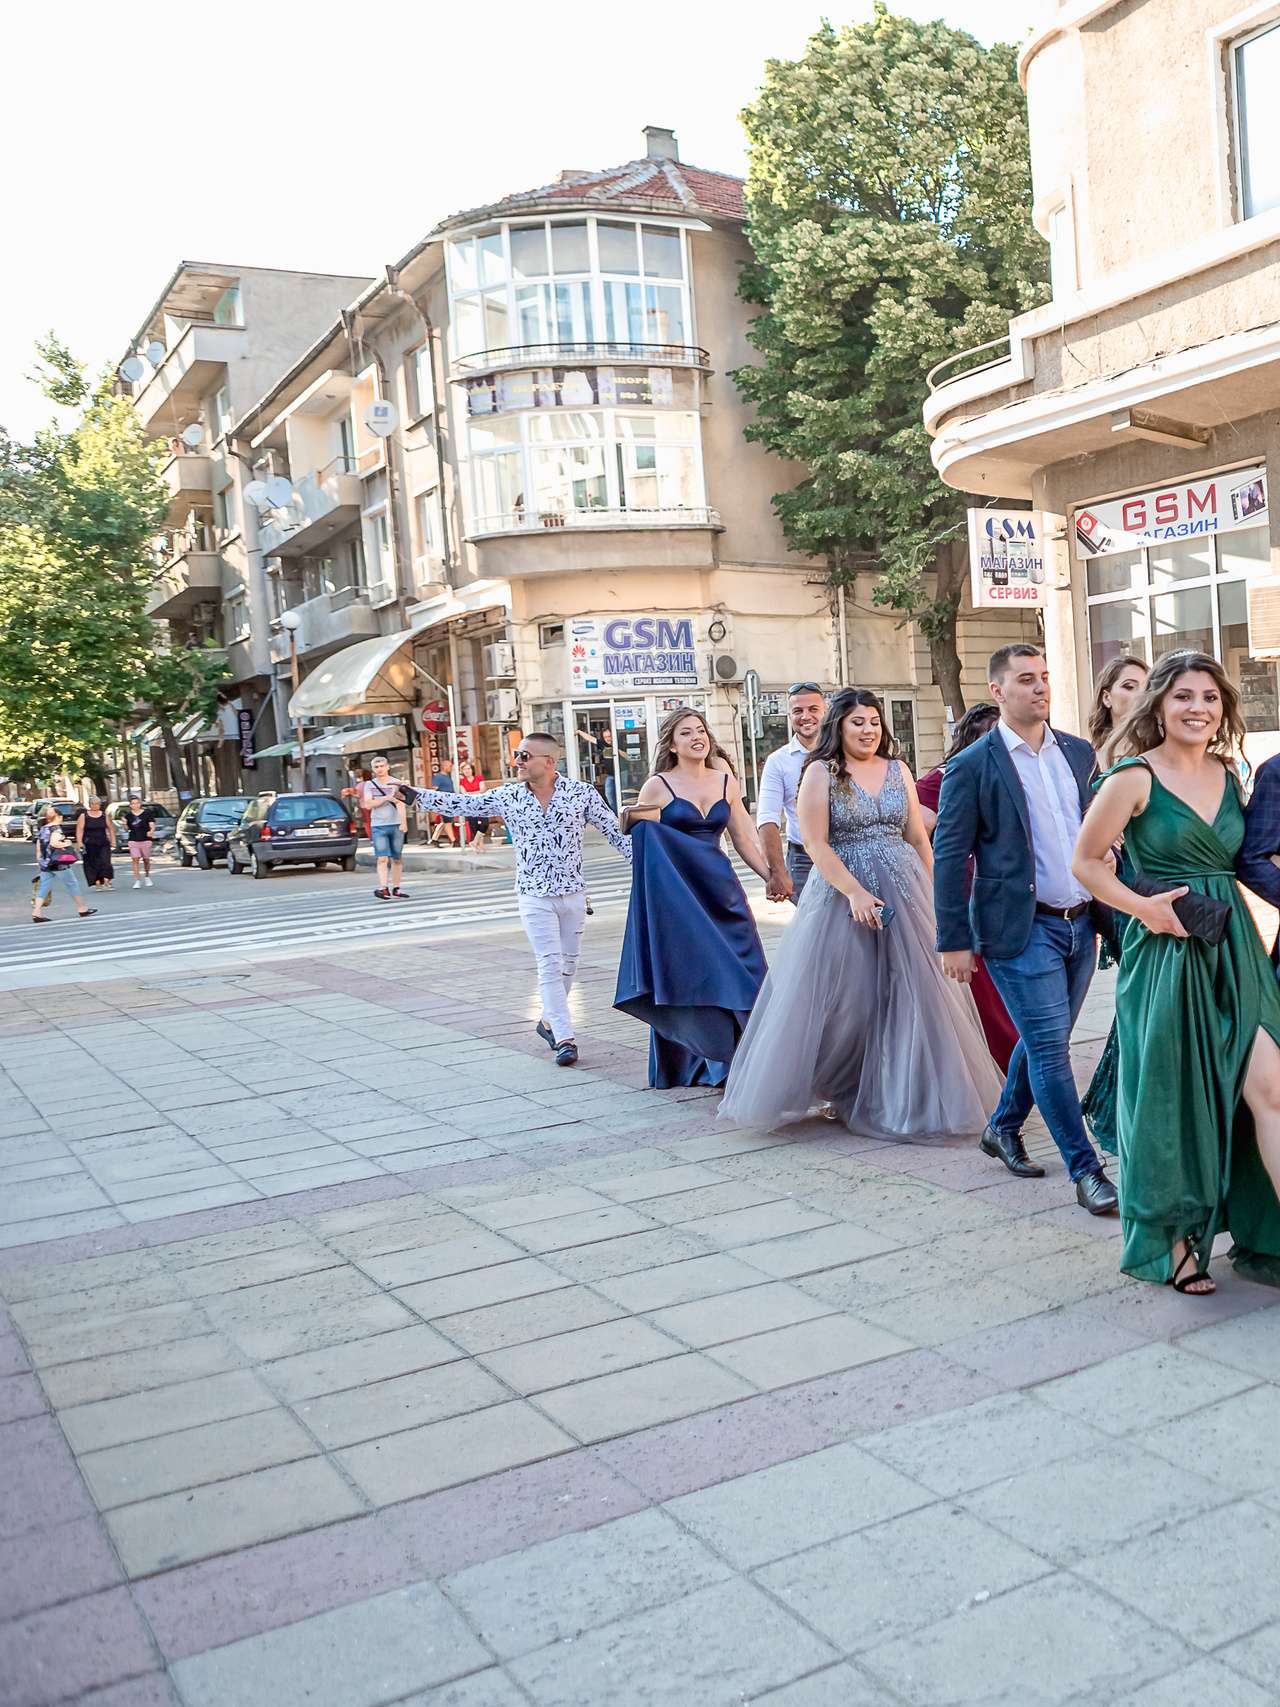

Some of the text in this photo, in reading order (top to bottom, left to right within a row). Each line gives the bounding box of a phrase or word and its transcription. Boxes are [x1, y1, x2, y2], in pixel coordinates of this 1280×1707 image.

[1122, 483, 1217, 532] GSM
[985, 517, 1036, 539] GSM
[1136, 517, 1218, 545] АГАЗИН
[980, 556, 1043, 570] МАГАЗИН
[989, 586, 1038, 600] СЕРВИЗ
[603, 618, 694, 651] GSM
[603, 652, 697, 675] МАГАЗИН
